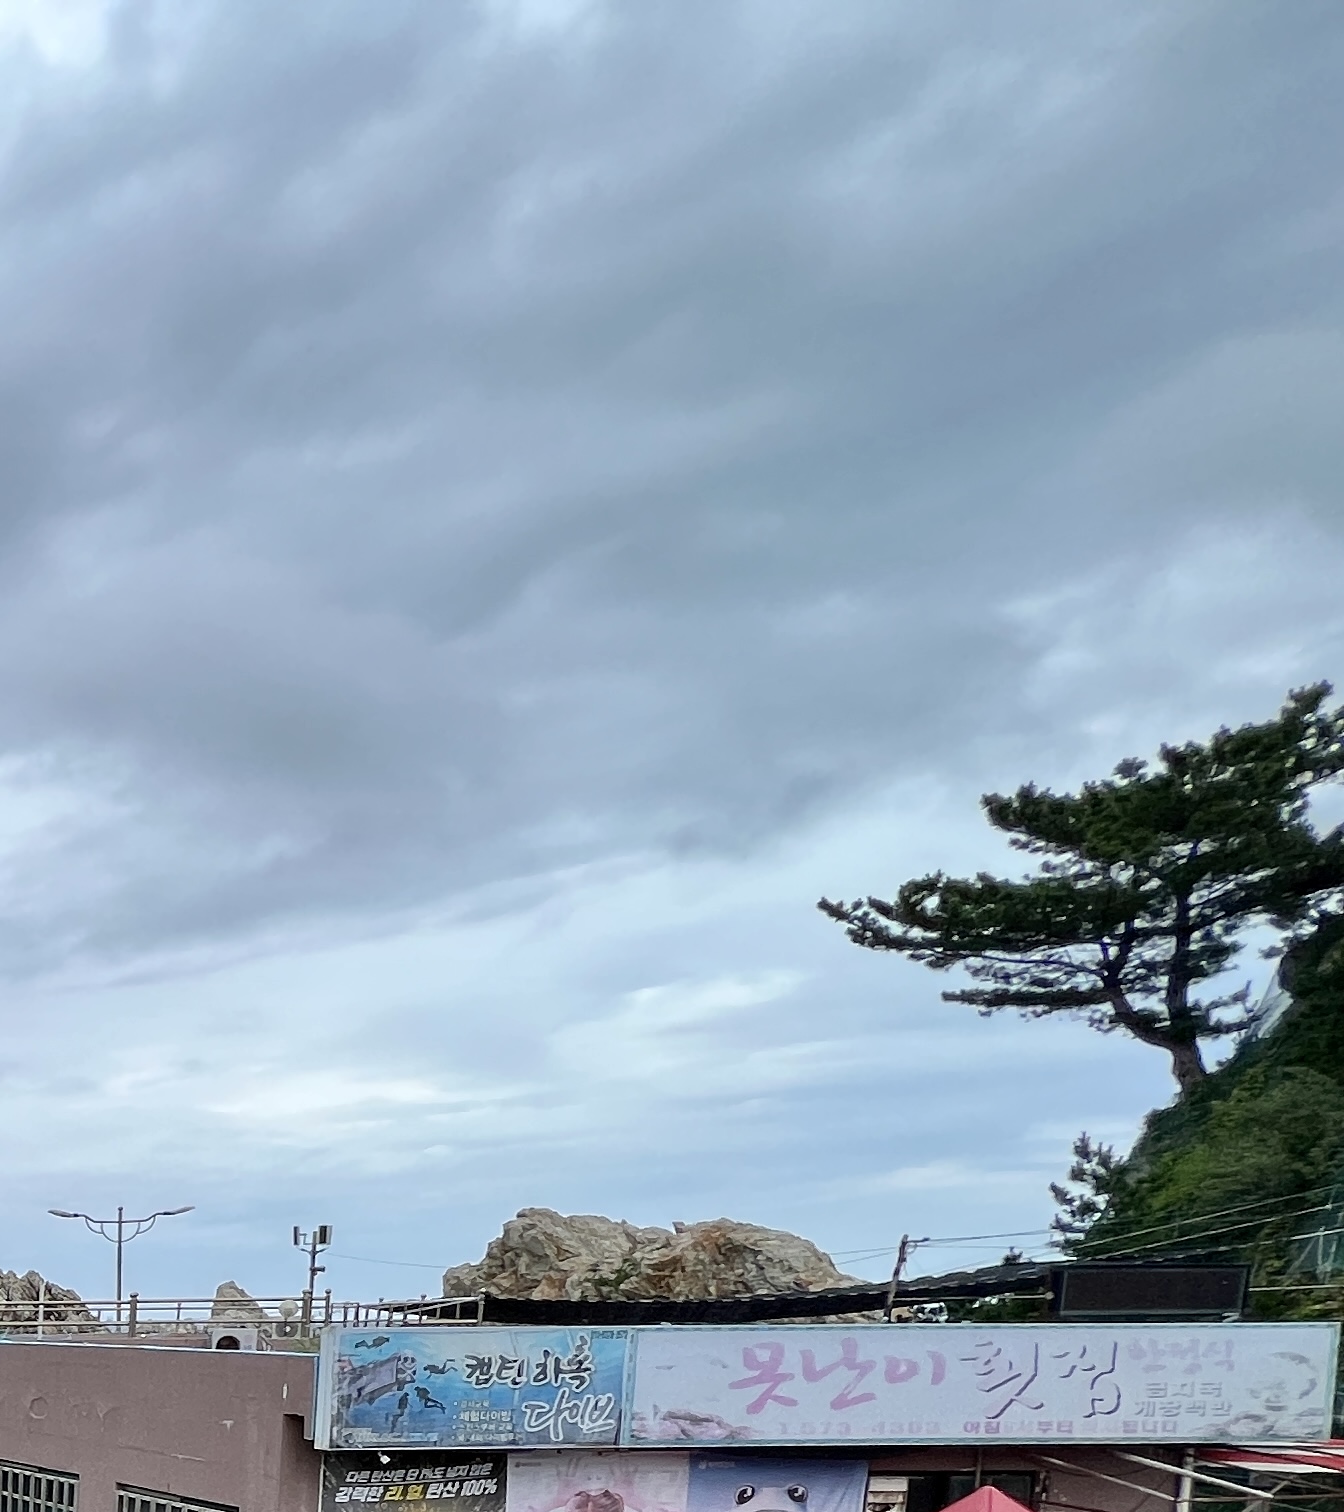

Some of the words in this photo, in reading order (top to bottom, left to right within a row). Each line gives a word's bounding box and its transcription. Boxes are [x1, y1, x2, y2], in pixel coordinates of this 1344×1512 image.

[728, 1337, 947, 1415] 못난이
[960, 1341, 1123, 1419] 횟집
[522, 1387, 616, 1442] 다이브
[335, 1486, 384, 1503] 강력한
[425, 1481, 460, 1499] 탄산
[460, 1478, 498, 1497] 100%
